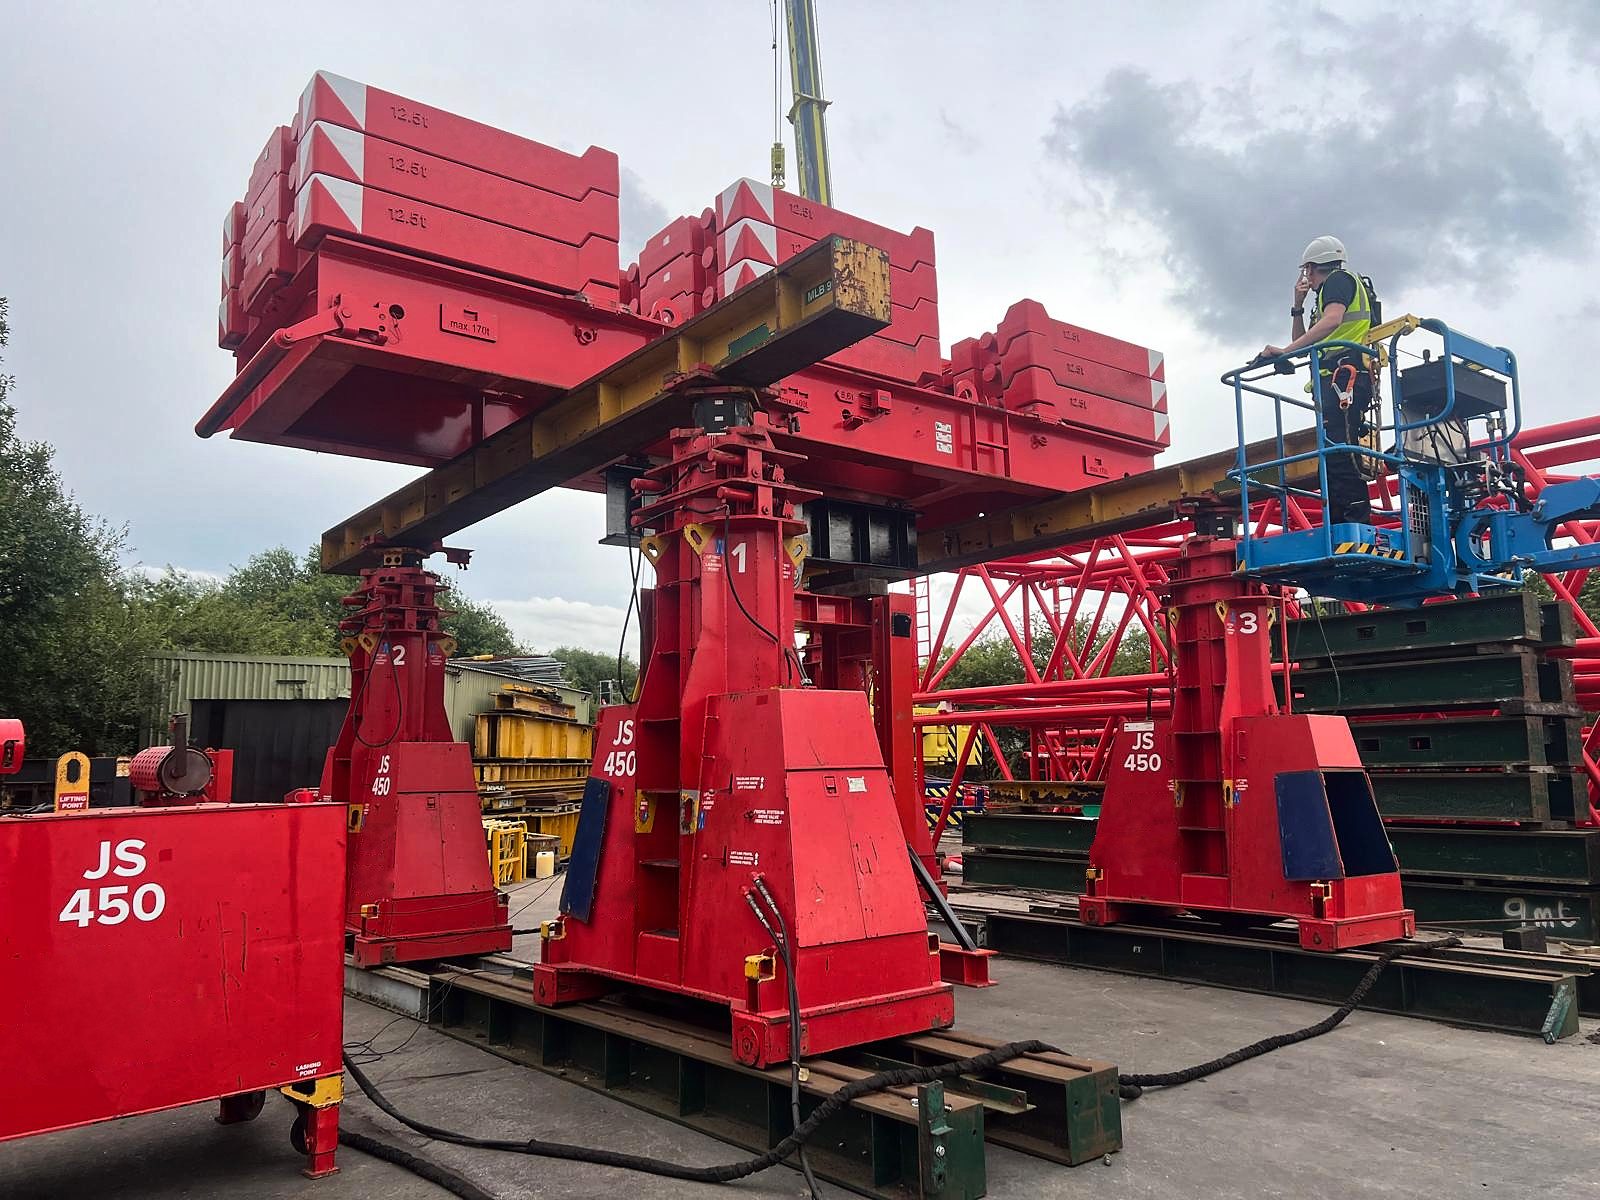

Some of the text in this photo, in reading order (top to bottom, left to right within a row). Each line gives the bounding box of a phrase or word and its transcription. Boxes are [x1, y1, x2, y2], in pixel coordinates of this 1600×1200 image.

[390, 106, 428, 128] 12.5t
[389, 157, 427, 178] 12.5t
[388, 208, 427, 229] 12.5t
[807, 280, 832, 302] MLB 9
[731, 542, 747, 573] 1
[1240, 612, 1258, 634] 3
[392, 645, 406, 666] 2
[612, 719, 634, 746] JS
[1132, 732, 1154, 750] JS
[378, 755, 390, 774] JS
[603, 750, 636, 776] 450
[1124, 753, 1161, 772] 450
[372, 777, 391, 796] 450
[60, 795, 87, 803] LIFTING
[83, 839, 147, 880] JS
[58, 883, 166, 928] 450
[295, 1061, 322, 1072] LASHING
[299, 1068, 318, 1077] POINT
